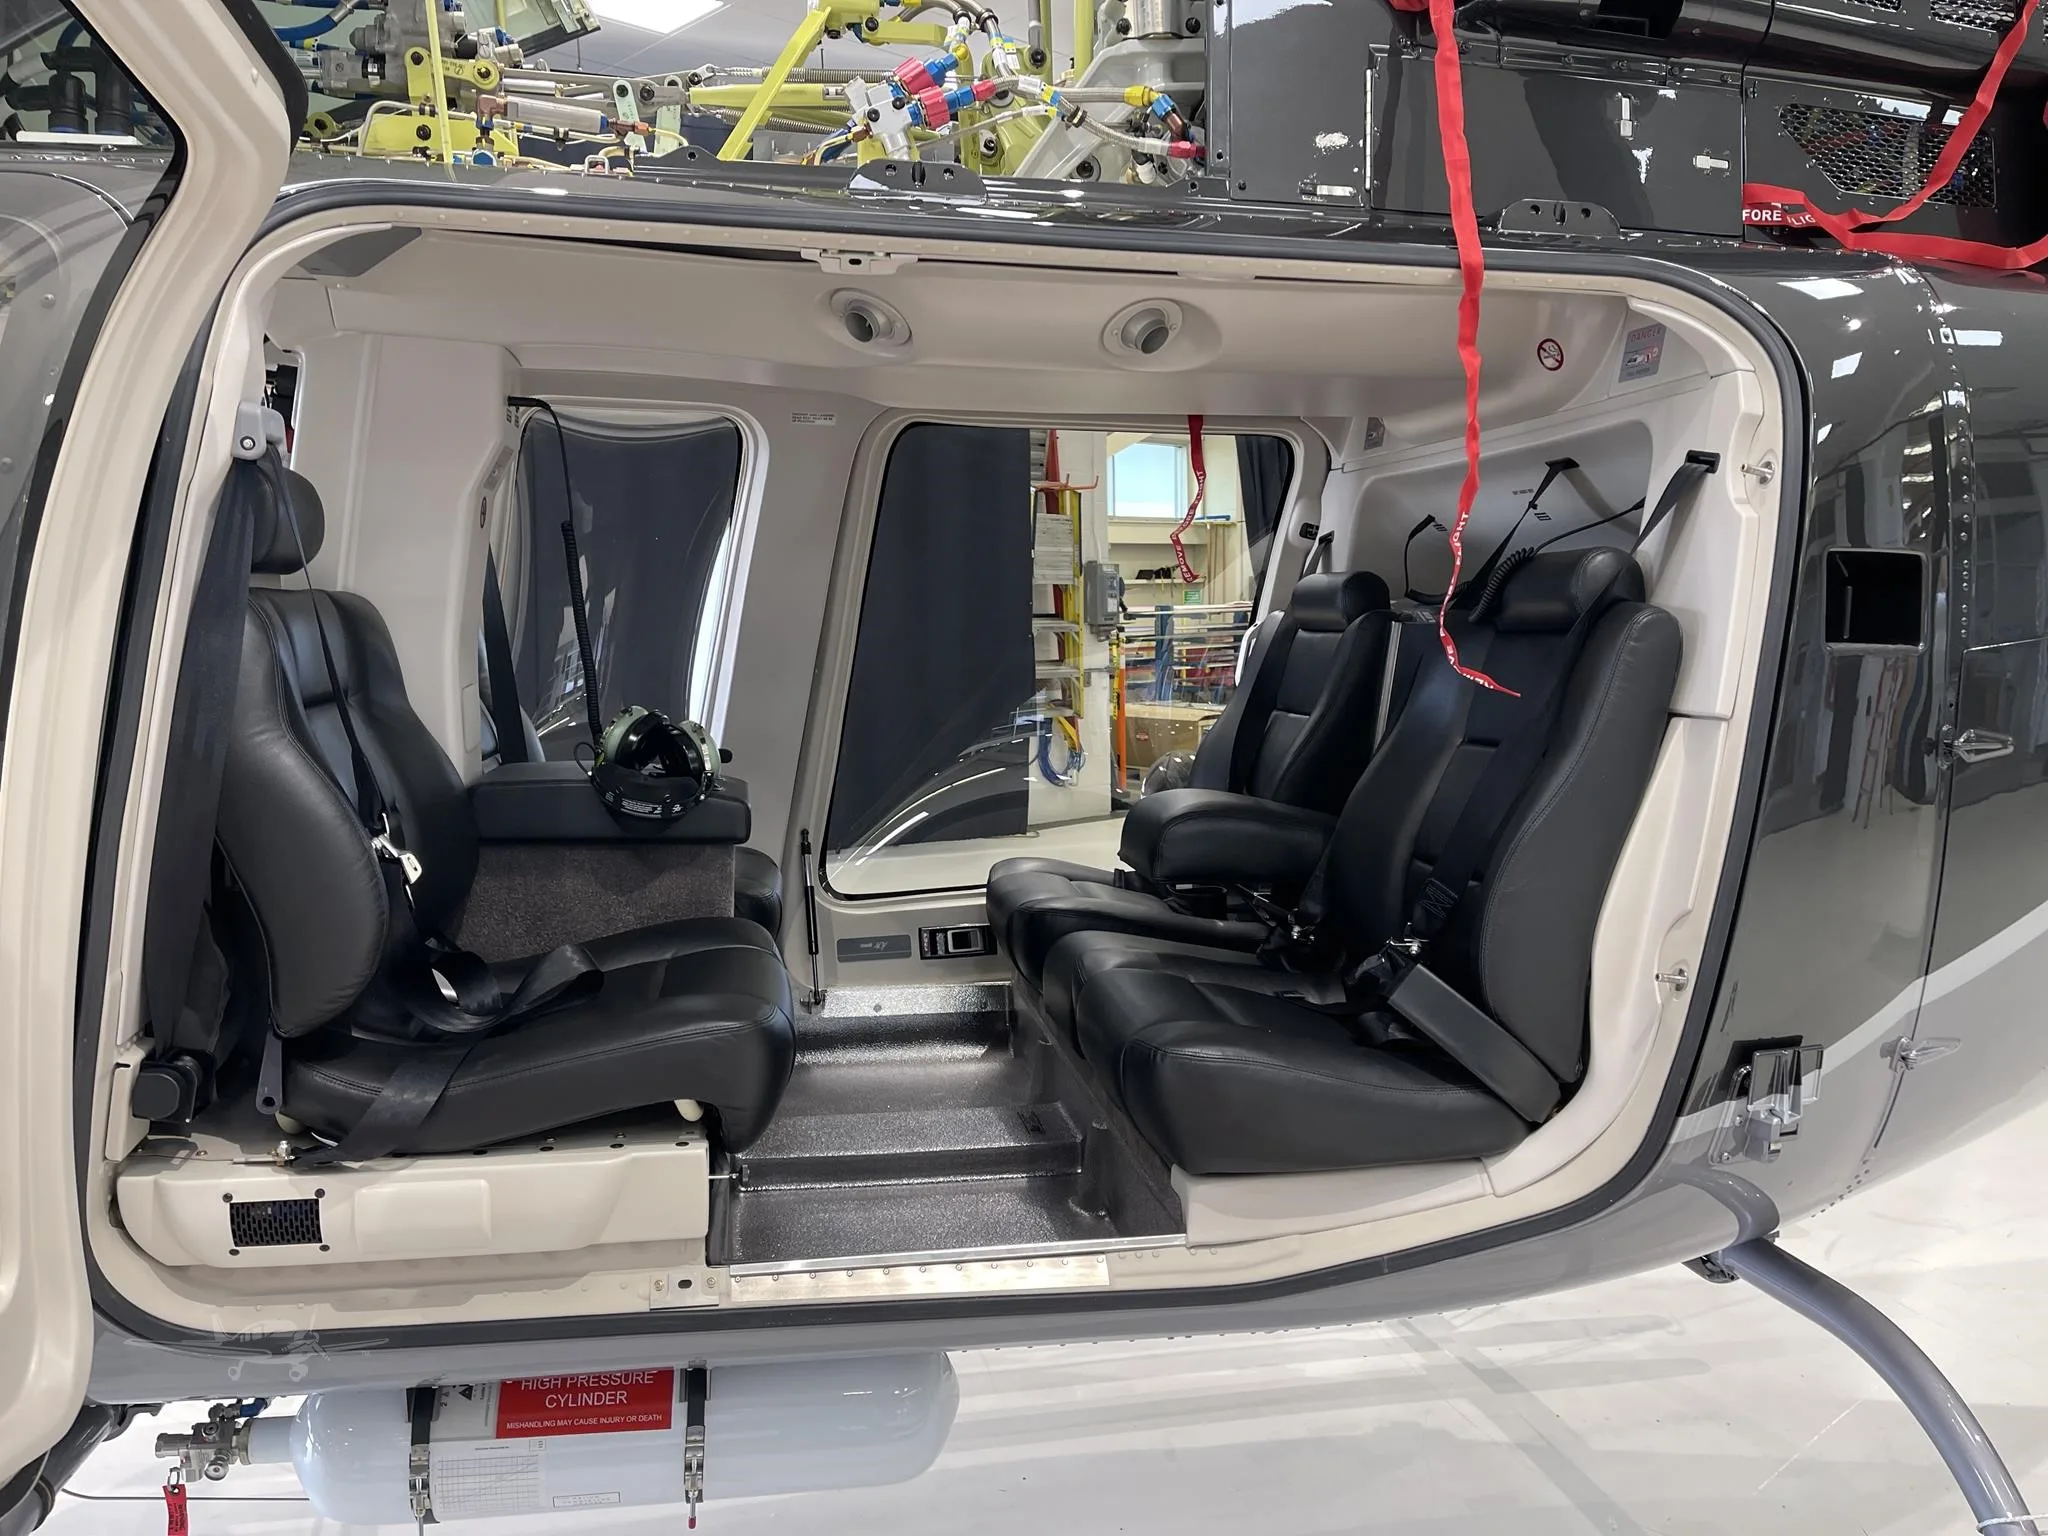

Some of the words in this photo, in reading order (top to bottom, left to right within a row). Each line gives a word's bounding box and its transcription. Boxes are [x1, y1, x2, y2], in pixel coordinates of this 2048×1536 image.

[1742, 209, 1782, 221] FORE
[521, 1378, 561, 1390] HIGH
[567, 1371, 655, 1387] PRESSURE
[545, 1391, 627, 1408] CYLINDER
[506, 1420, 555, 1429] MISHANDLING
